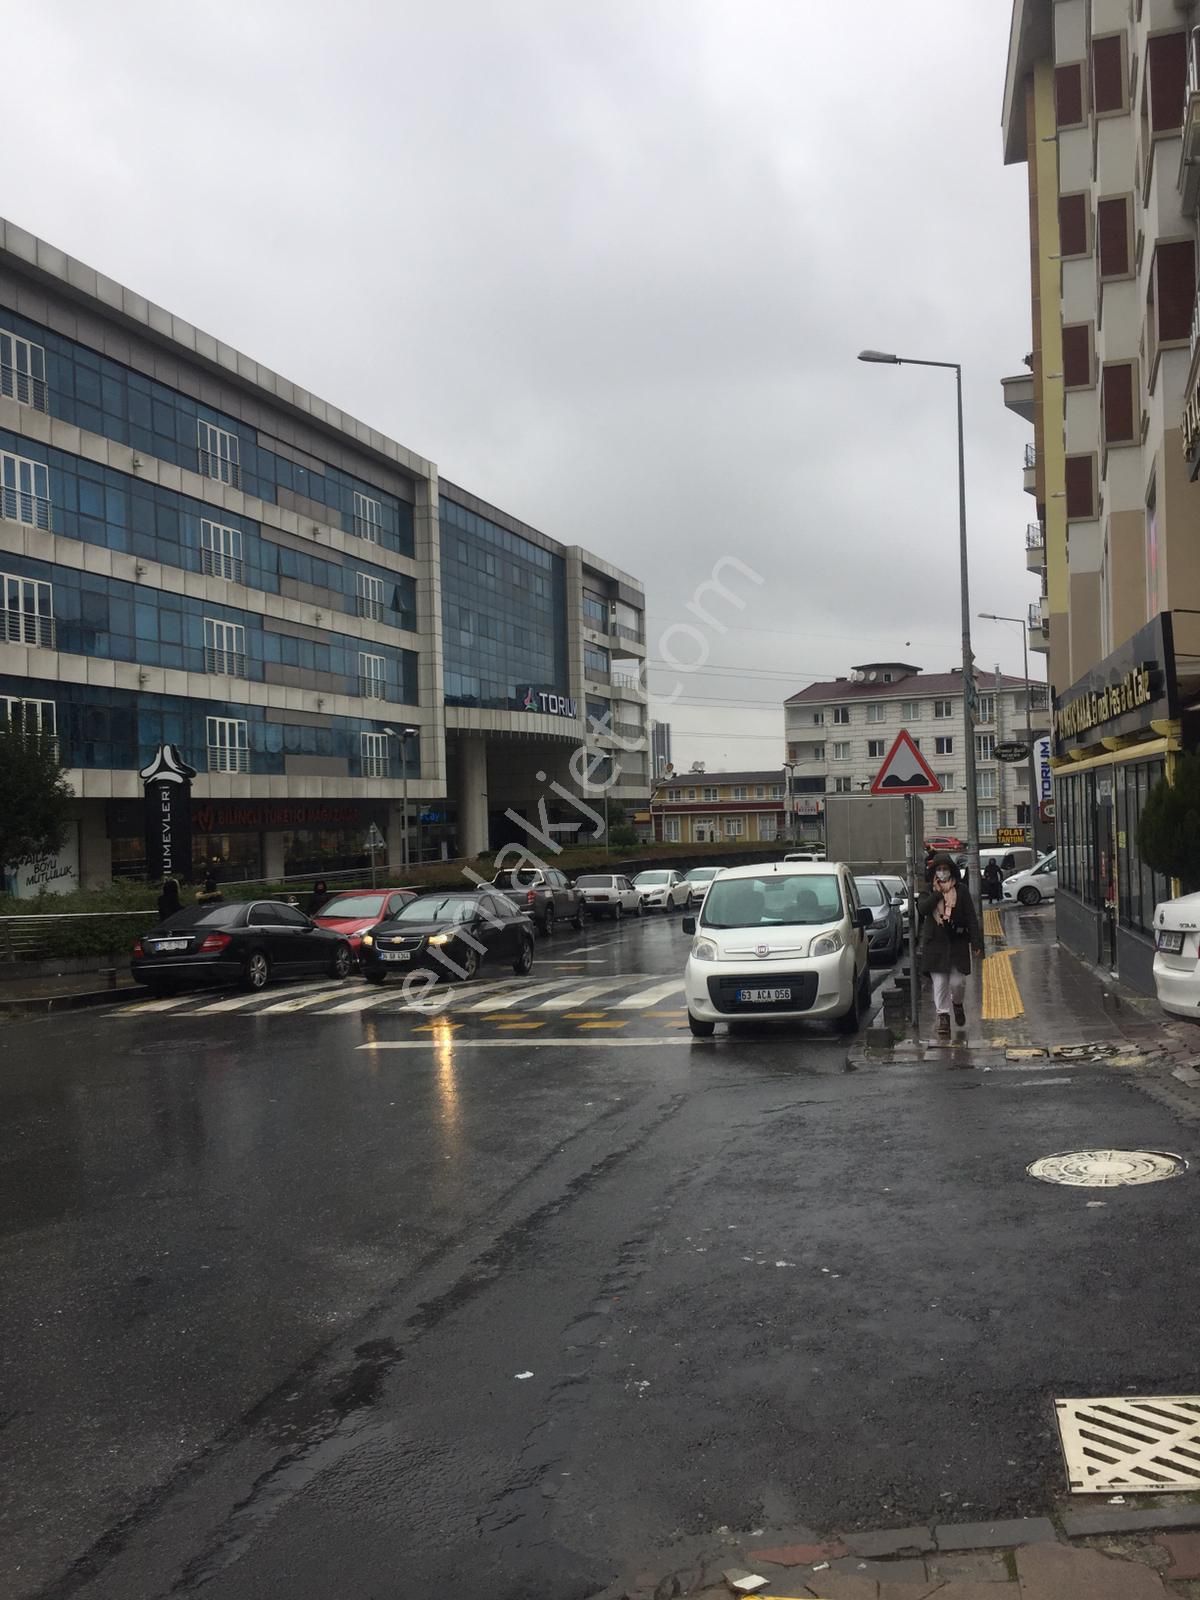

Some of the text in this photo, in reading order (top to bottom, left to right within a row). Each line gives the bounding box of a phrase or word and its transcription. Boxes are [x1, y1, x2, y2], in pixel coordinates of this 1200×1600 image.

[741, 989, 790, 1000] 63 ACA 056
